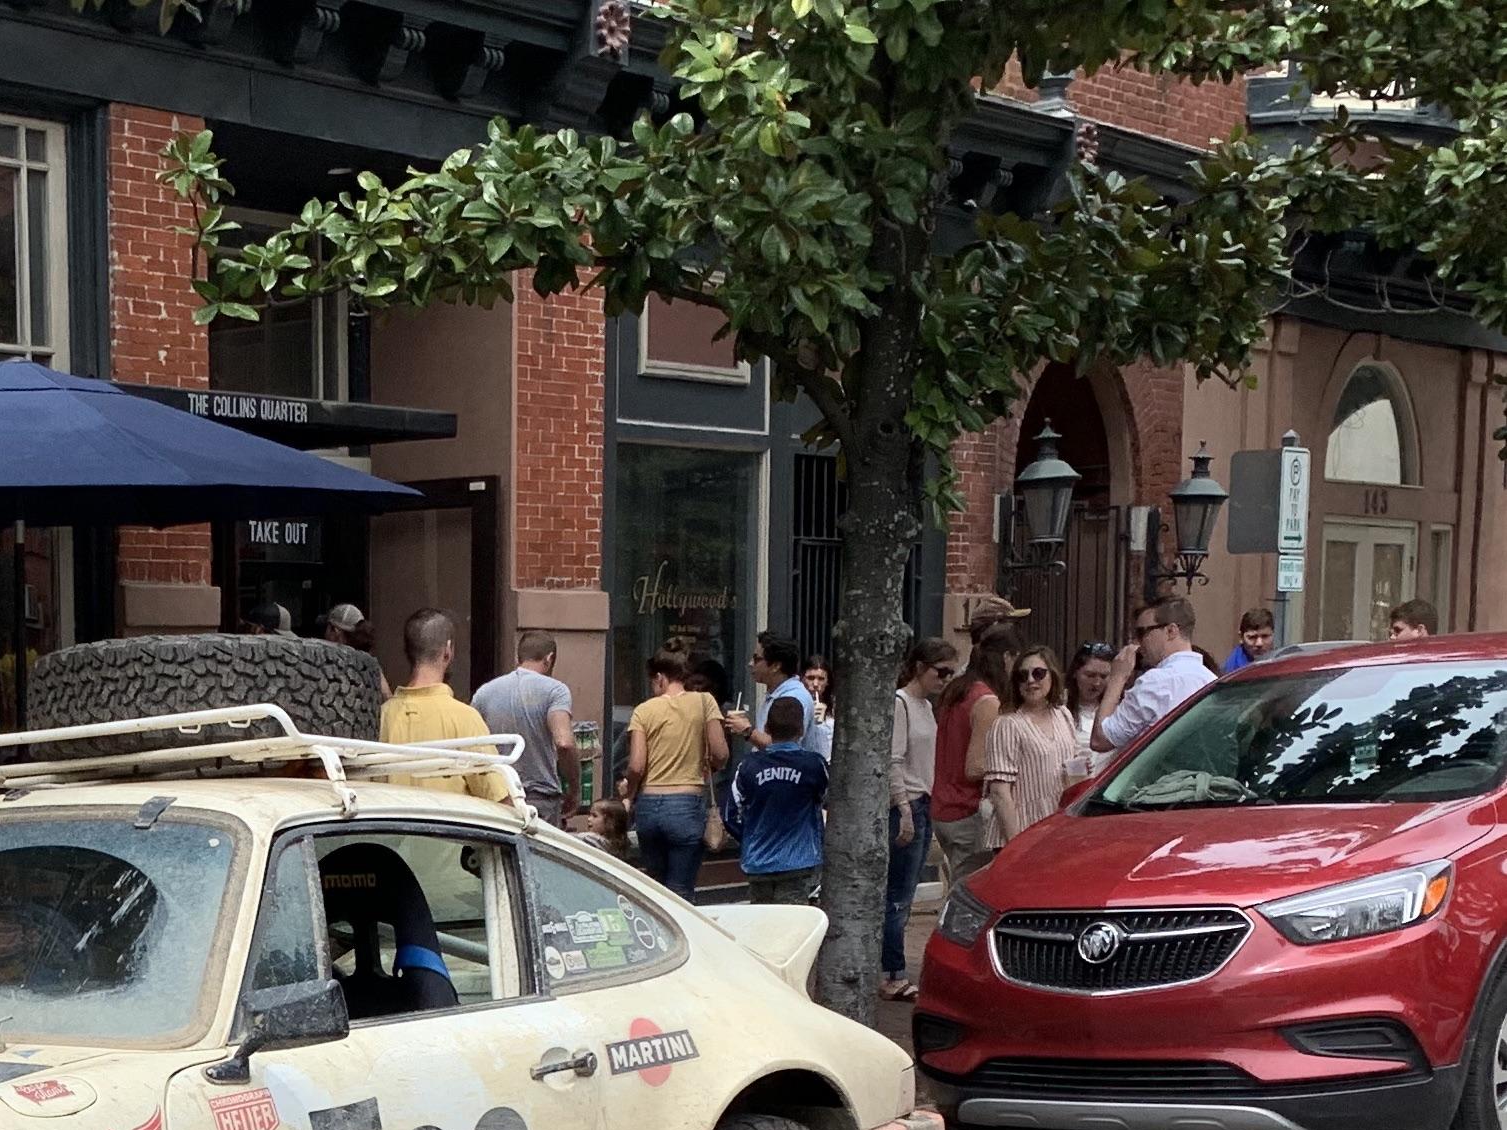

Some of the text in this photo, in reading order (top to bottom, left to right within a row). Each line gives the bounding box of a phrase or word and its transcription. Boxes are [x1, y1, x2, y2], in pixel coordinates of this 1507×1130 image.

[188, 393, 308, 423] THE COLLINS QUARTER
[249, 520, 308, 545] TAKE OUT
[755, 766, 802, 786] ZENITH
[610, 1033, 694, 1070] MARTINI
